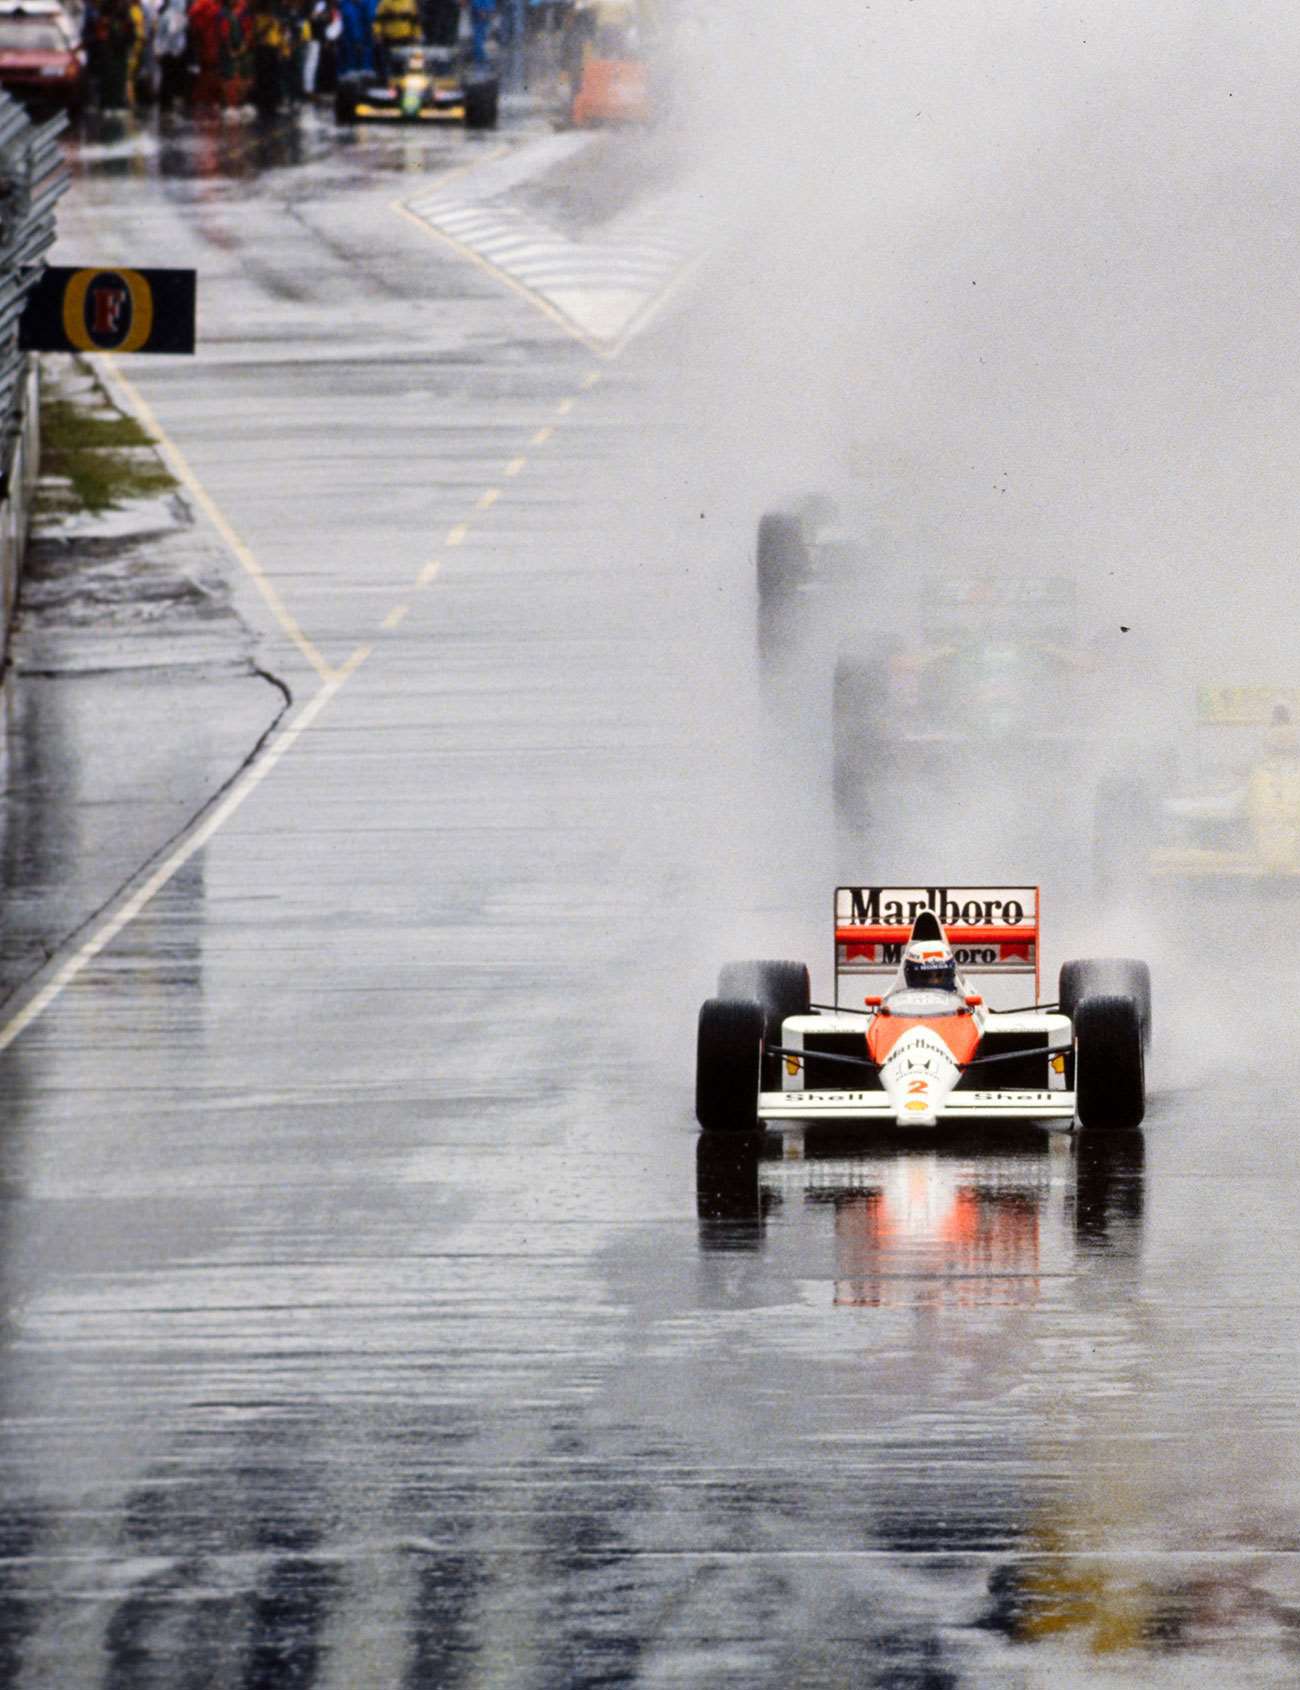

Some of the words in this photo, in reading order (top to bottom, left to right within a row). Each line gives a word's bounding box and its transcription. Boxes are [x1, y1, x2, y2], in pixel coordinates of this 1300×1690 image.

[850, 888, 1024, 926] Marlboro
[881, 943, 997, 965] Moro
[906, 1080, 929, 1094] 2
[785, 1093, 864, 1101] Shell
[974, 1093, 1053, 1101] Shell
